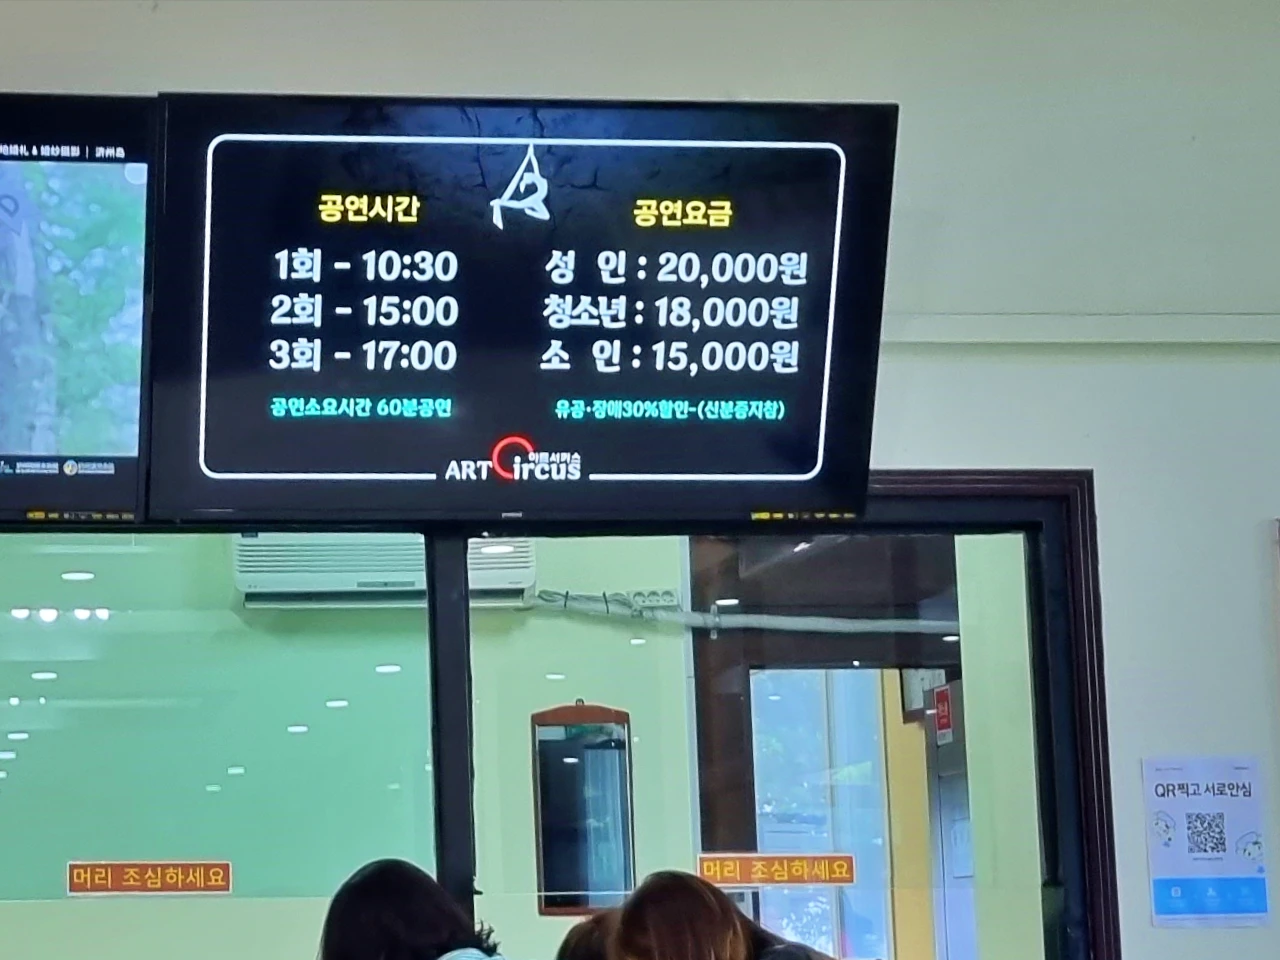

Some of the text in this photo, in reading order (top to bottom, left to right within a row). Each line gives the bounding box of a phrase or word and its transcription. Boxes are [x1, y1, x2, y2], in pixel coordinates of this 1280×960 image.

[319, 195, 420, 222] 공연시간
[634, 199, 732, 227] 공연요금
[275, 248, 321, 282] 1회
[362, 250, 458, 281] 10:30
[545, 250, 575, 284] 성
[597, 250, 626, 283] 인
[657, 252, 808, 289] 20,000원
[271, 293, 322, 327] 2회
[363, 295, 459, 326] 15:00
[543, 294, 626, 329] 청소년
[655, 296, 799, 333] 18,000원
[269, 338, 321, 372] 3회
[362, 340, 457, 370] 17:00
[540, 340, 570, 369] 소
[592, 340, 620, 373] 인
[652, 340, 799, 377] 15,000원
[271, 398, 452, 417] 공연소요시간 60분공연
[445, 460, 493, 480] ART
[1154, 782, 1251, 797] QR찍고 서로안심
[73, 866, 226, 889] 머리 조심하세요
[703, 859, 850, 881] 머리 조심하세요
